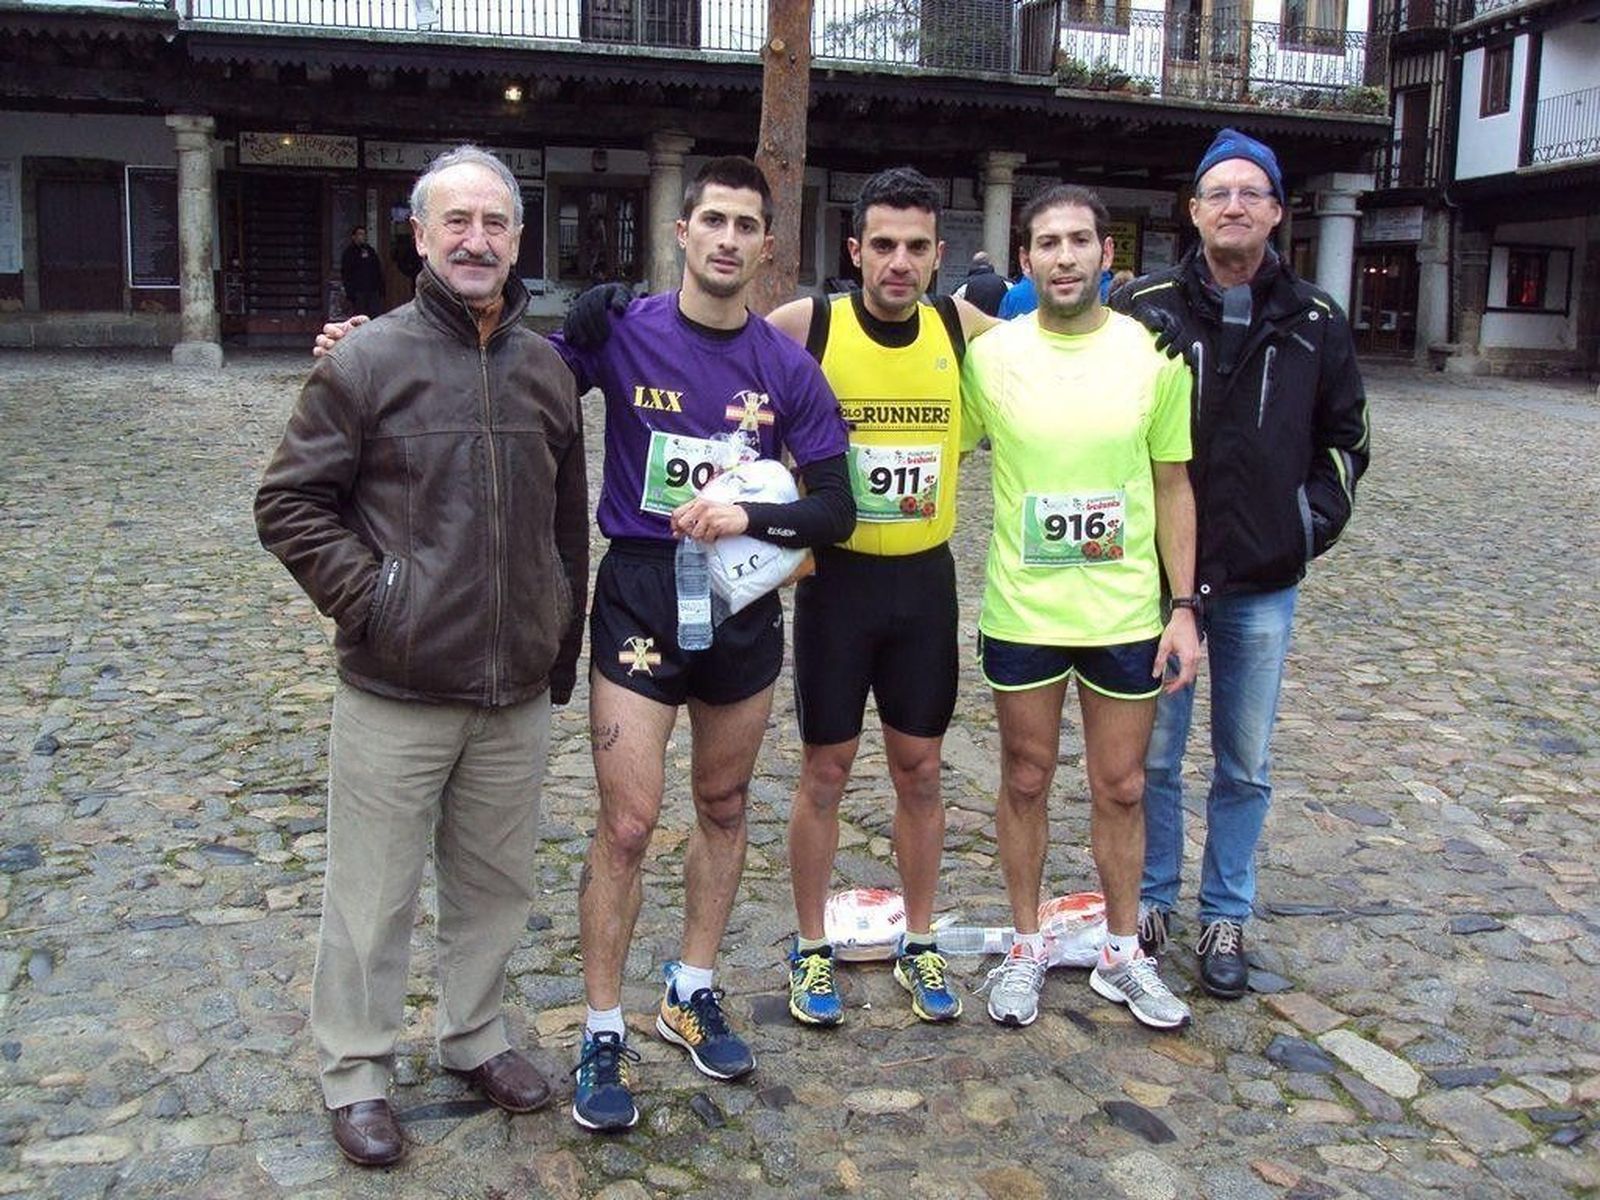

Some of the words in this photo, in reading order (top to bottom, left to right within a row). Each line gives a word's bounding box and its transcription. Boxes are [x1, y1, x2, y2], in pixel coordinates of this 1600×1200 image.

[633, 385, 684, 413] LXX
[862, 407, 951, 424] RUNNERS
[665, 457, 715, 491] 90
[869, 466, 921, 495] 911
[1044, 512, 1106, 541] 916
